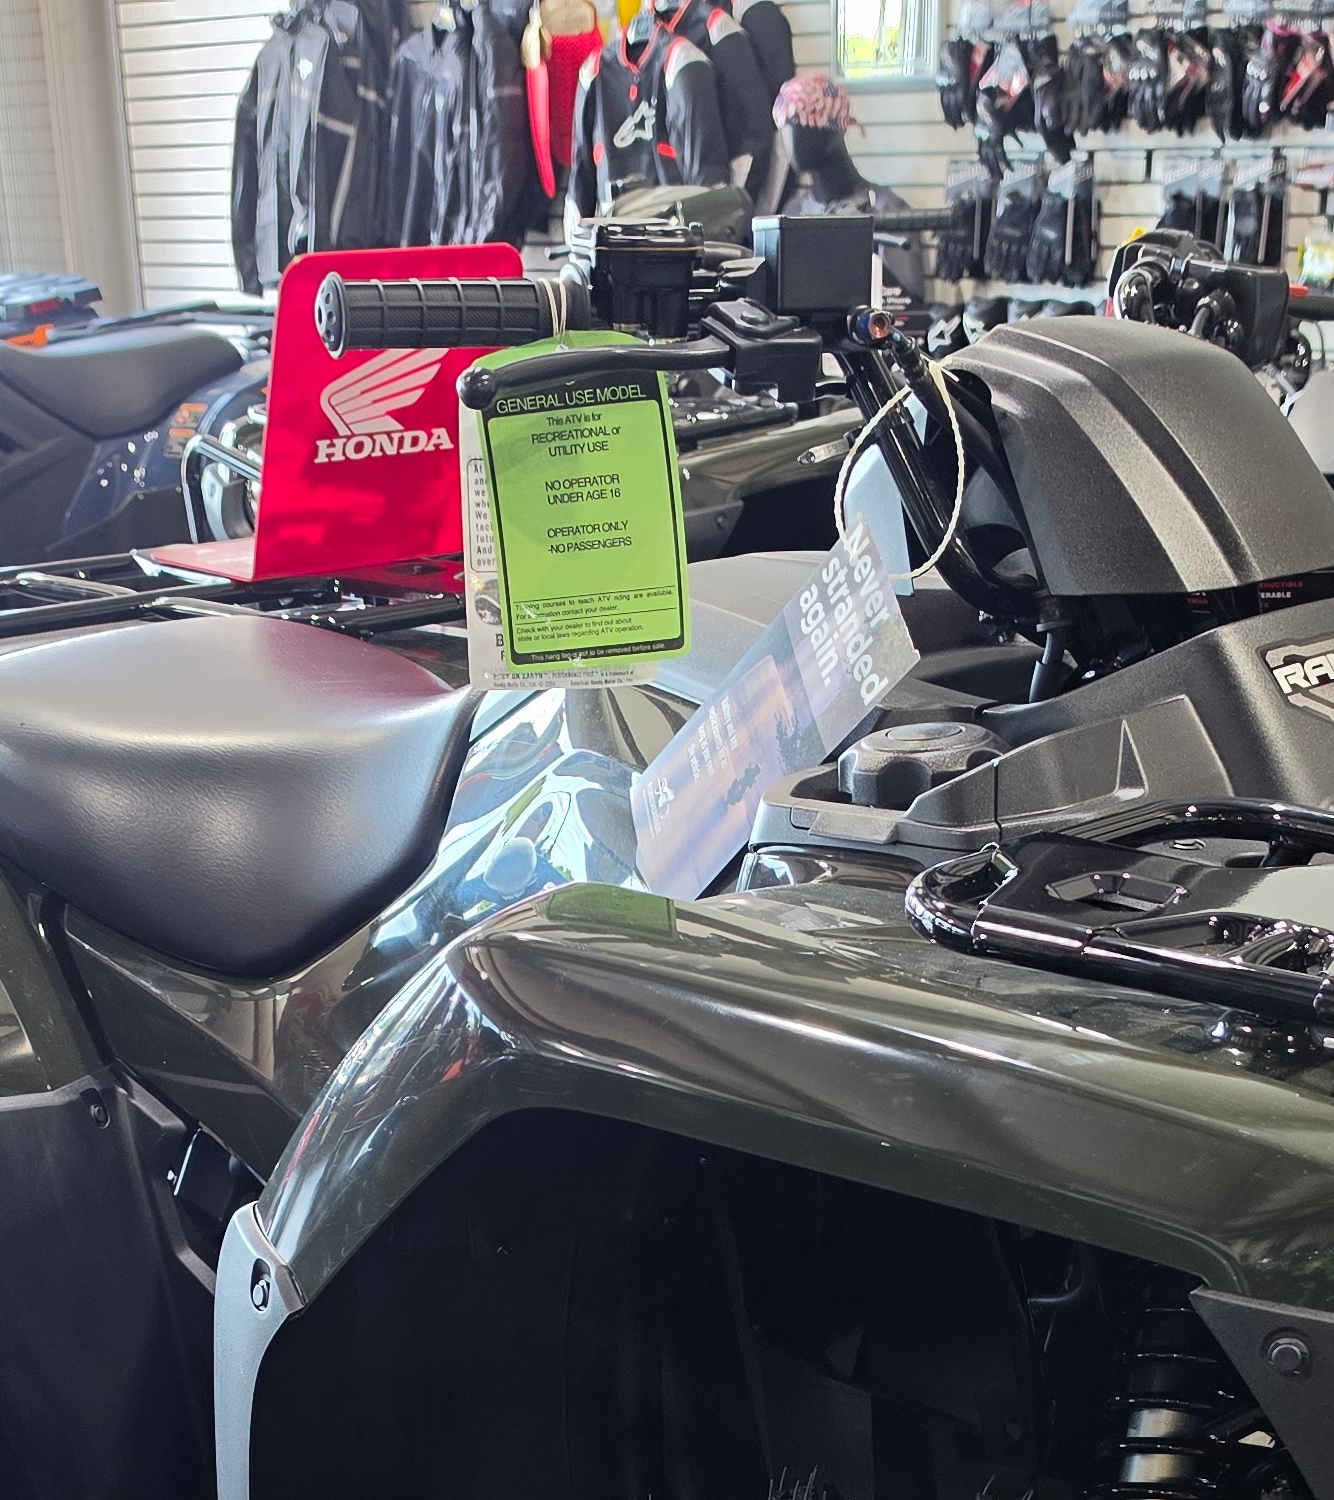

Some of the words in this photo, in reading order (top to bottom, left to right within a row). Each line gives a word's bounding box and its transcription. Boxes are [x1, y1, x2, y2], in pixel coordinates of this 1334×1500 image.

[497, 394, 564, 414] GENERAL
[565, 389, 594, 405] USE
[596, 384, 646, 402] MODEL
[546, 416, 563, 427] This
[565, 414, 583, 425] ATV
[583, 414, 591, 423] is
[591, 413, 602, 421] for
[531, 426, 611, 444] RECREATIONAL
[611, 426, 621, 435] or
[314, 427, 455, 464] HONDA
[549, 444, 586, 457] UTILITY
[588, 441, 609, 453] USE
[545, 480, 561, 492] NO
[563, 474, 620, 490] OPERATOR
[547, 491, 584, 505] UNDER
[585, 489, 608, 502] AGE
[609, 488, 621, 498] 16
[547, 523, 601, 538] OPERATOR
[602, 520, 628, 532] ONLY
[548, 543, 565, 555] -NO
[567, 536, 632, 553] PASSENGERS
[844, 521, 891, 628] Never
[800, 583, 839, 688] again.
[822, 557, 889, 706] stranded
